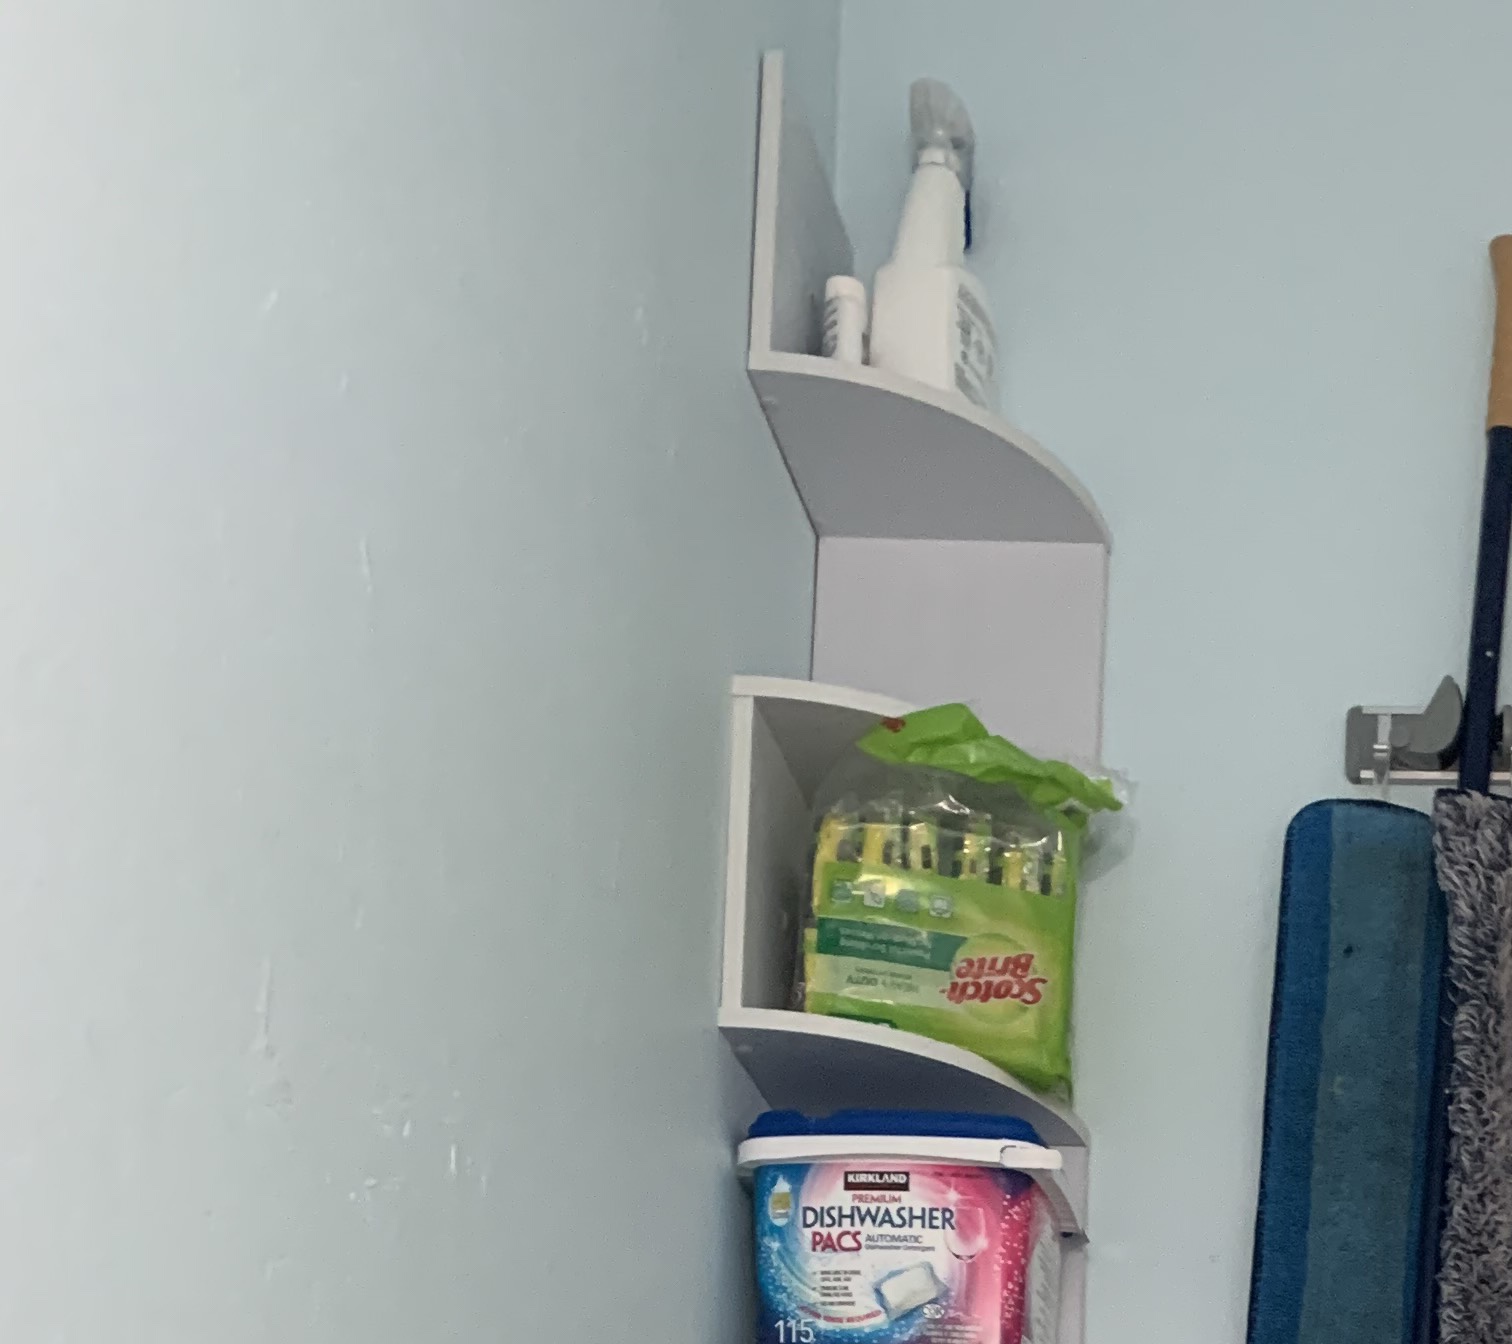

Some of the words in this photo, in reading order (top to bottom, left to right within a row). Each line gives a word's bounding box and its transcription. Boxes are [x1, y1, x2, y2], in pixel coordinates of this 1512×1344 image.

[956, 953, 1034, 979] Brite
[939, 978, 1049, 1005] Scotch-
[847, 1173, 907, 1184] KIRKLAND
[802, 1205, 956, 1230] DISHWASHER
[811, 1231, 863, 1253] PACS
[865, 1233, 923, 1244] AUTOMATIC
[774, 1319, 814, 1344] 115
